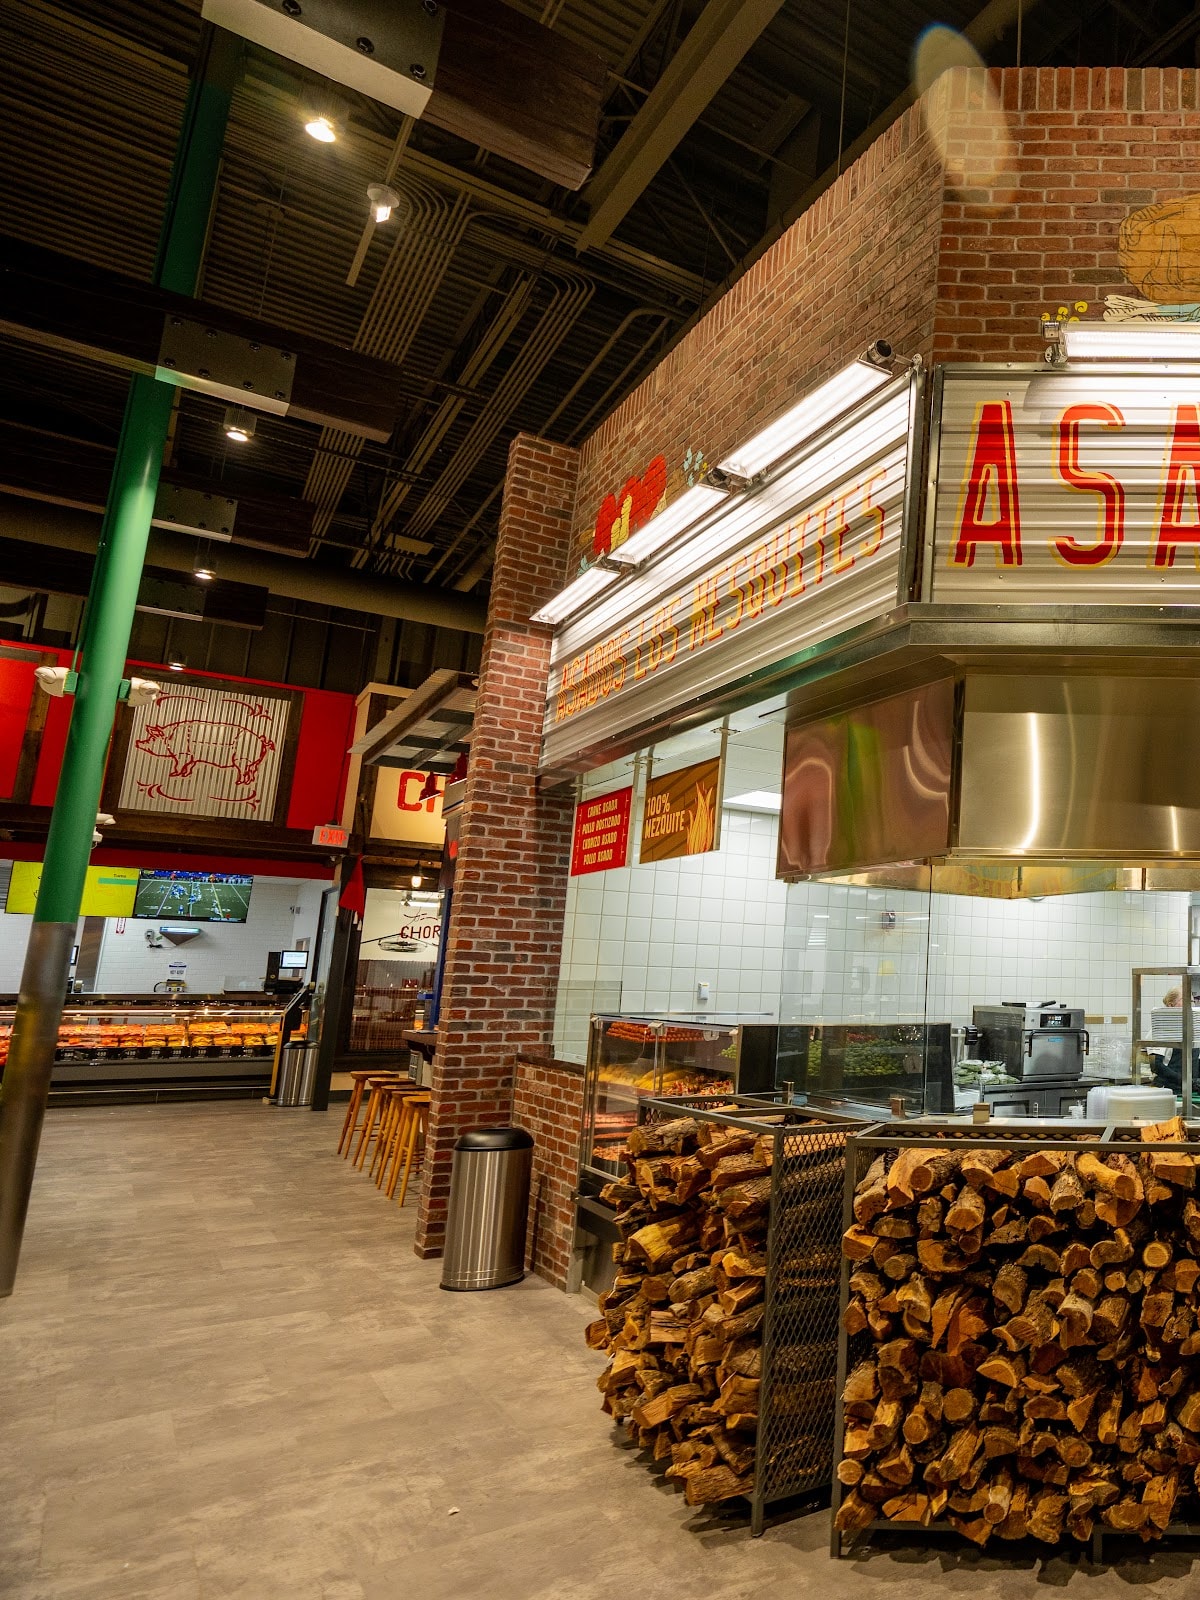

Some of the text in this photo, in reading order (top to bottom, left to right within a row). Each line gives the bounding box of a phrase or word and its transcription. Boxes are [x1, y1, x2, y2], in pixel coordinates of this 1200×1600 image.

[554, 464, 887, 723] ASADOS LOS MESQUITES
[647, 792, 671, 818] 100%
[644, 810, 686, 839] MEZQUITE
